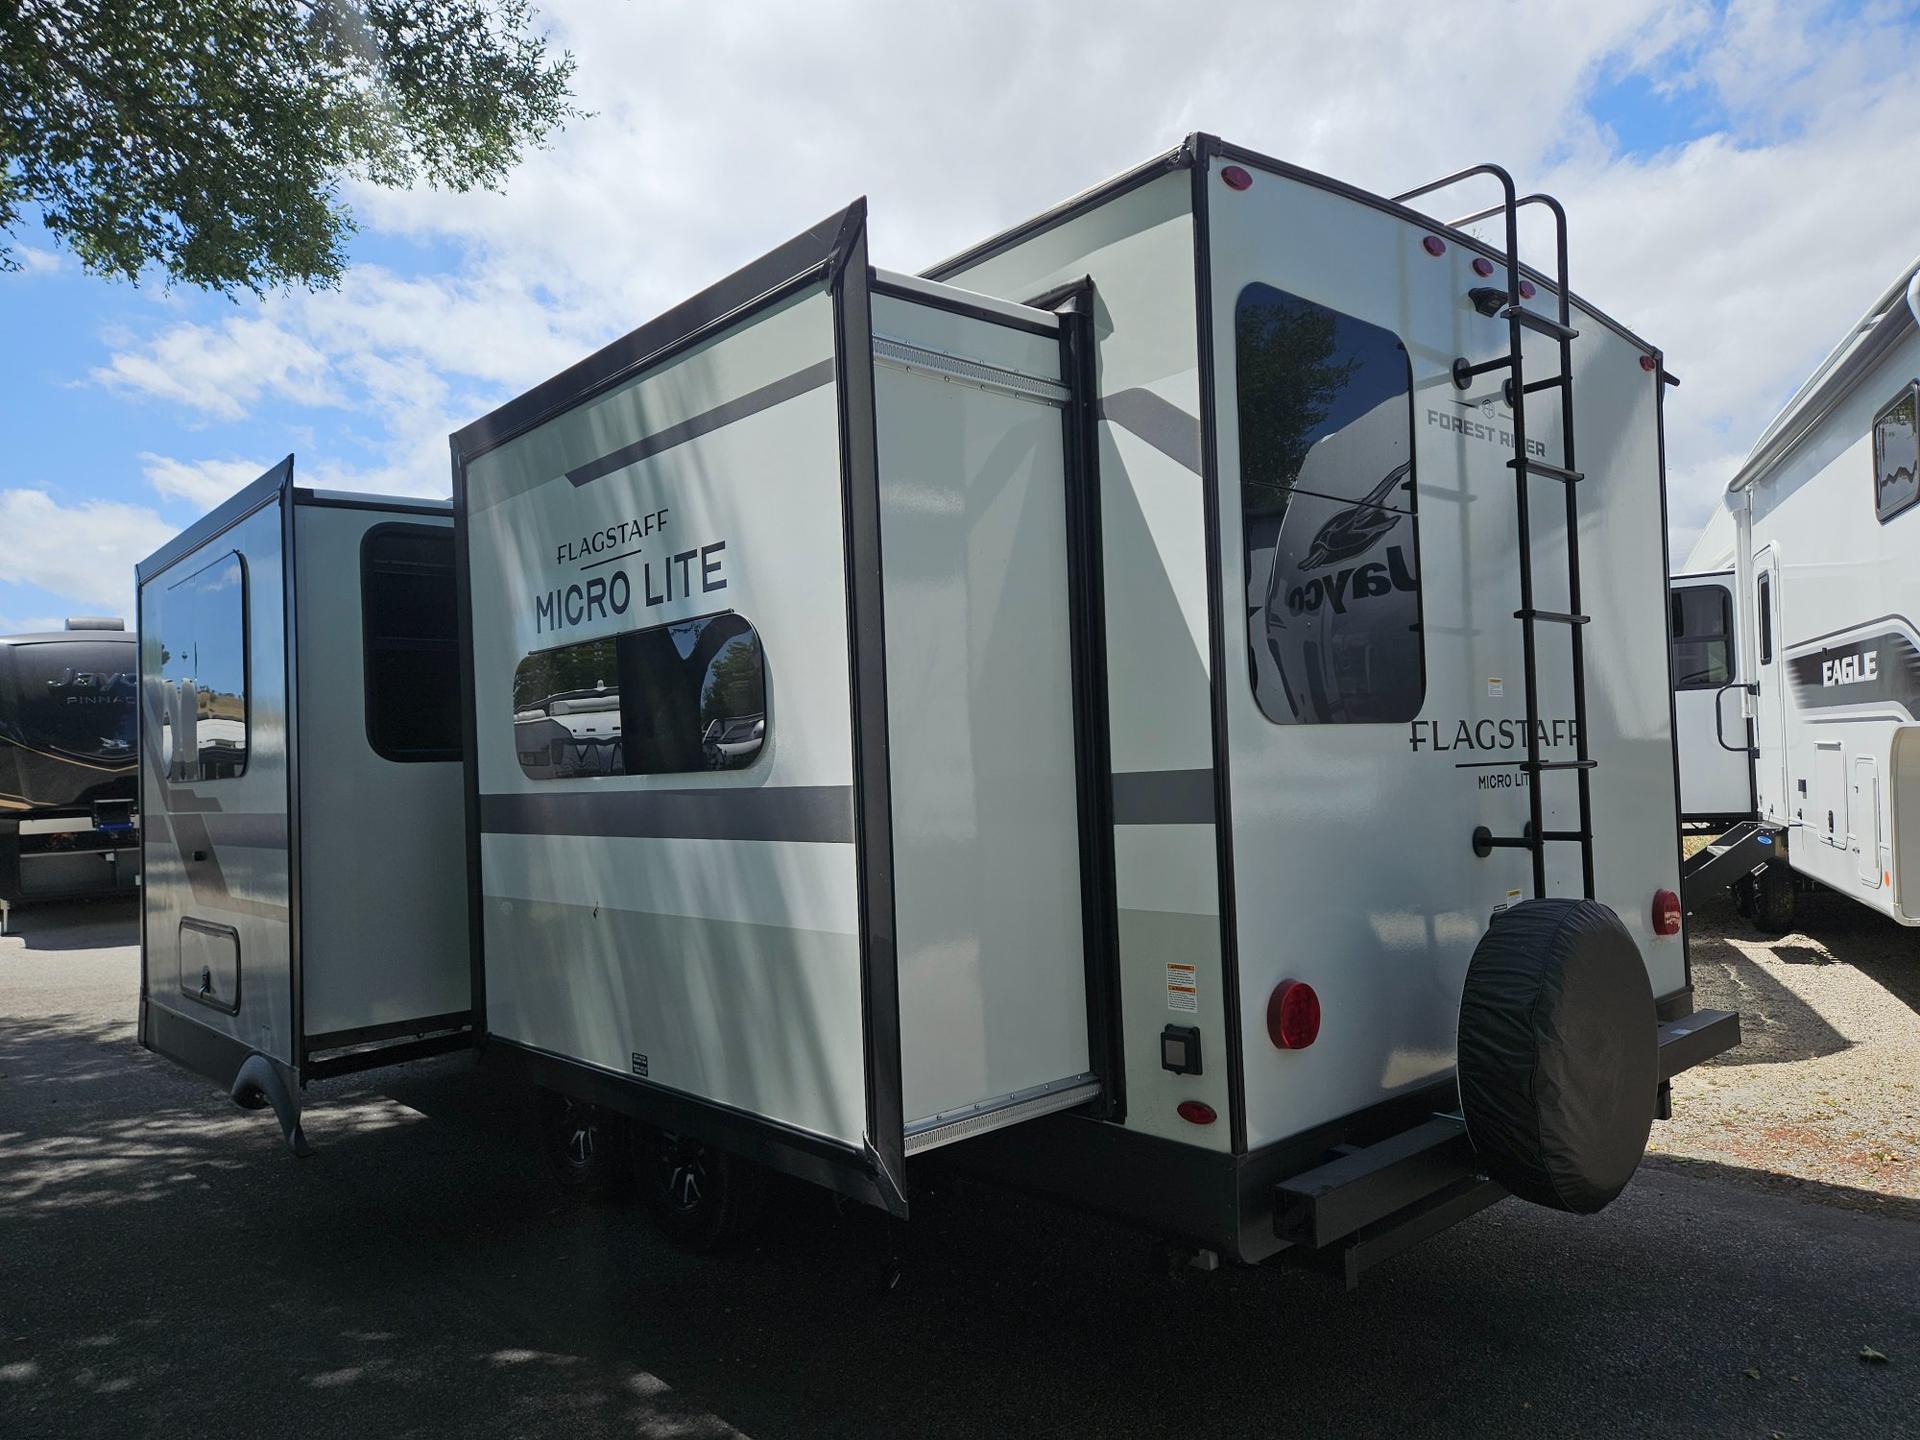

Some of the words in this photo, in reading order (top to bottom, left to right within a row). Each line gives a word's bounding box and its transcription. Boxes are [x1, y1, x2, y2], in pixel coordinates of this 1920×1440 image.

[1427, 408, 1496, 442] FOREST
[1498, 429, 1547, 457] RIER
[556, 508, 669, 565] FLAGSTAFF
[535, 570, 631, 634] MICRO
[644, 540, 728, 607] LITE
[1821, 650, 1879, 688] EAGLE
[66, 696, 136, 705] PINNAC
[1478, 773, 1512, 790] MICRO
[1515, 771, 1531, 787] LIT
